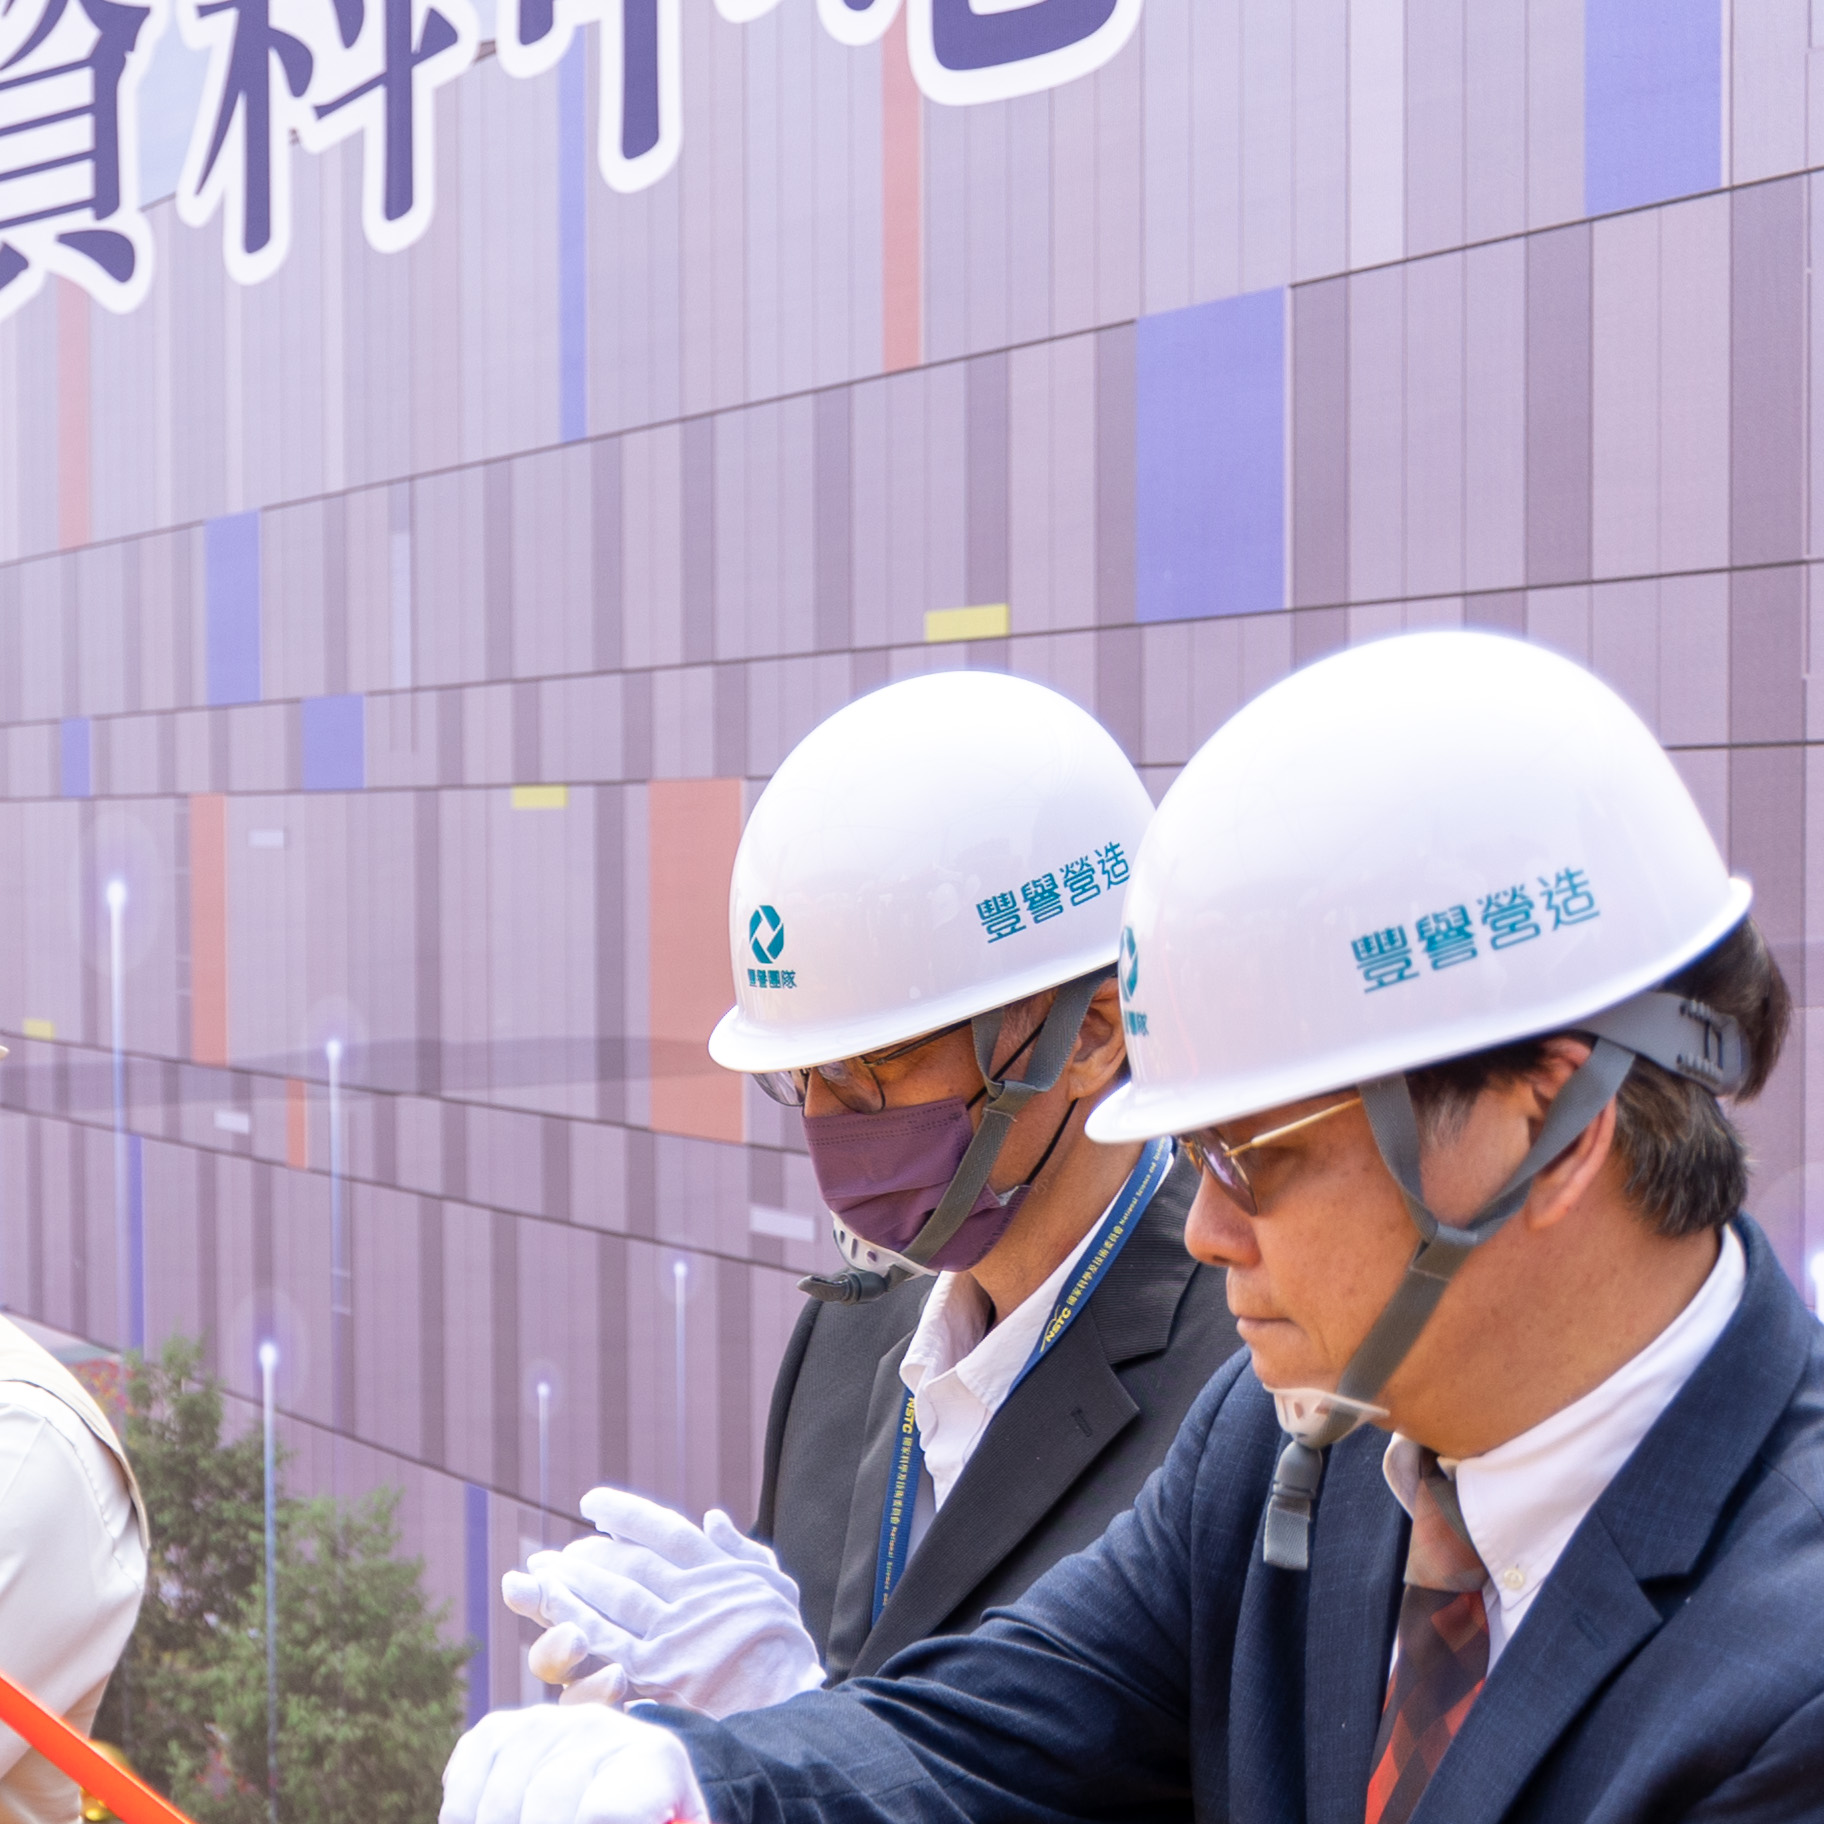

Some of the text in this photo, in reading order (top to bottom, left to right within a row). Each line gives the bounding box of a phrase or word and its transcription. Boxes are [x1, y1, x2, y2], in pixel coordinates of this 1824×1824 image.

[976, 841, 1131, 944] 豐譽營造
[1351, 866, 1601, 994] 豐譽營造
[1045, 1306, 1072, 1343] NSTC
